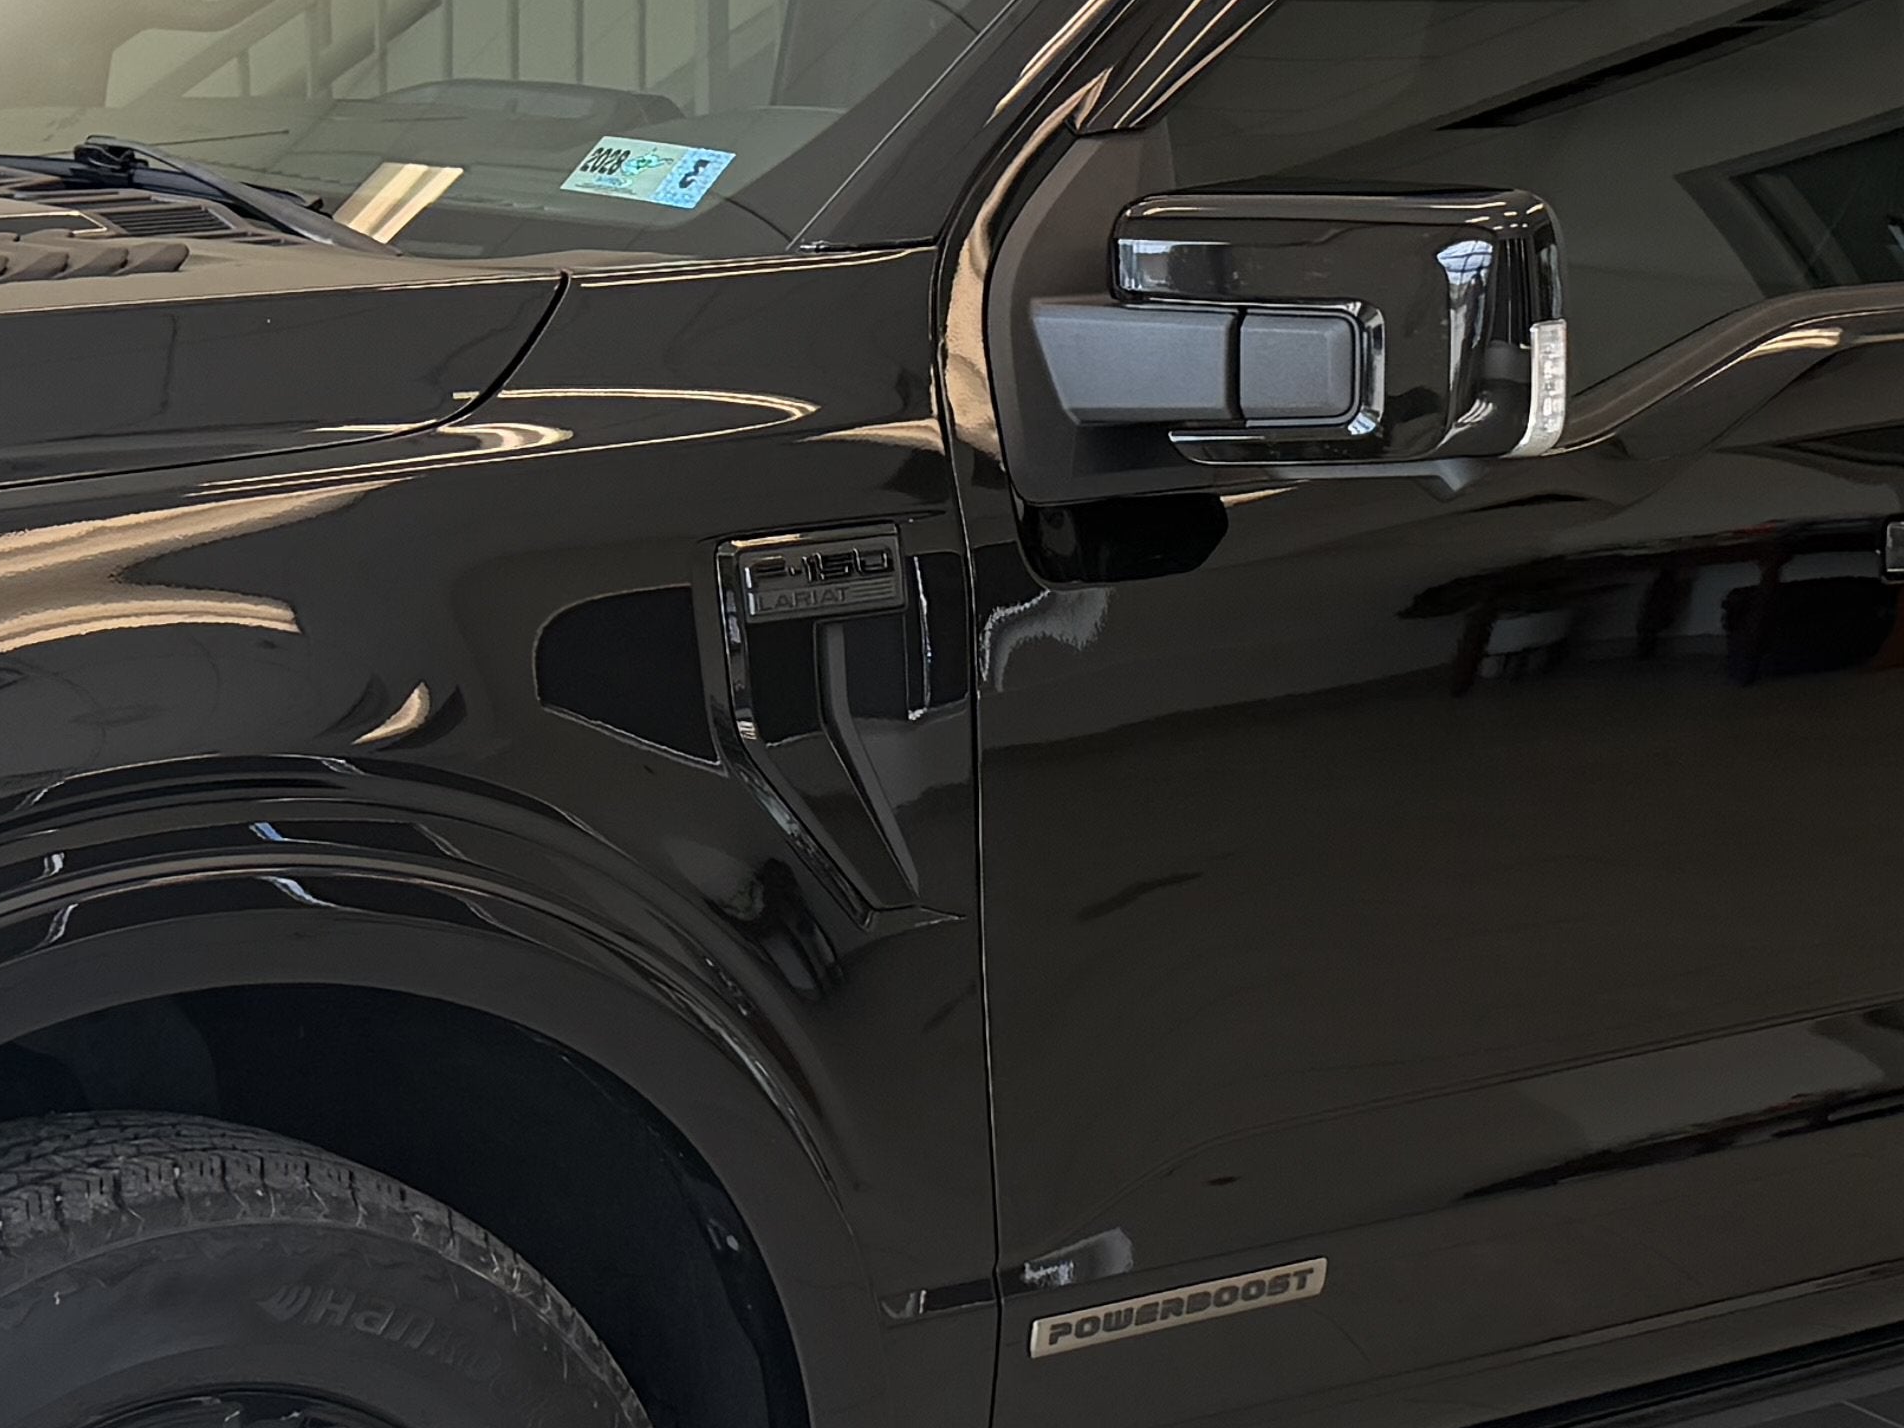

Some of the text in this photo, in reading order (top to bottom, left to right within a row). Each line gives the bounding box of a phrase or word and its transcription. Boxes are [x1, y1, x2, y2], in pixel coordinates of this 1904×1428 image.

[579, 147, 631, 176] 2028
[758, 586, 847, 612] LARIAT
[1048, 1267, 1314, 1346] POWERBOOST
